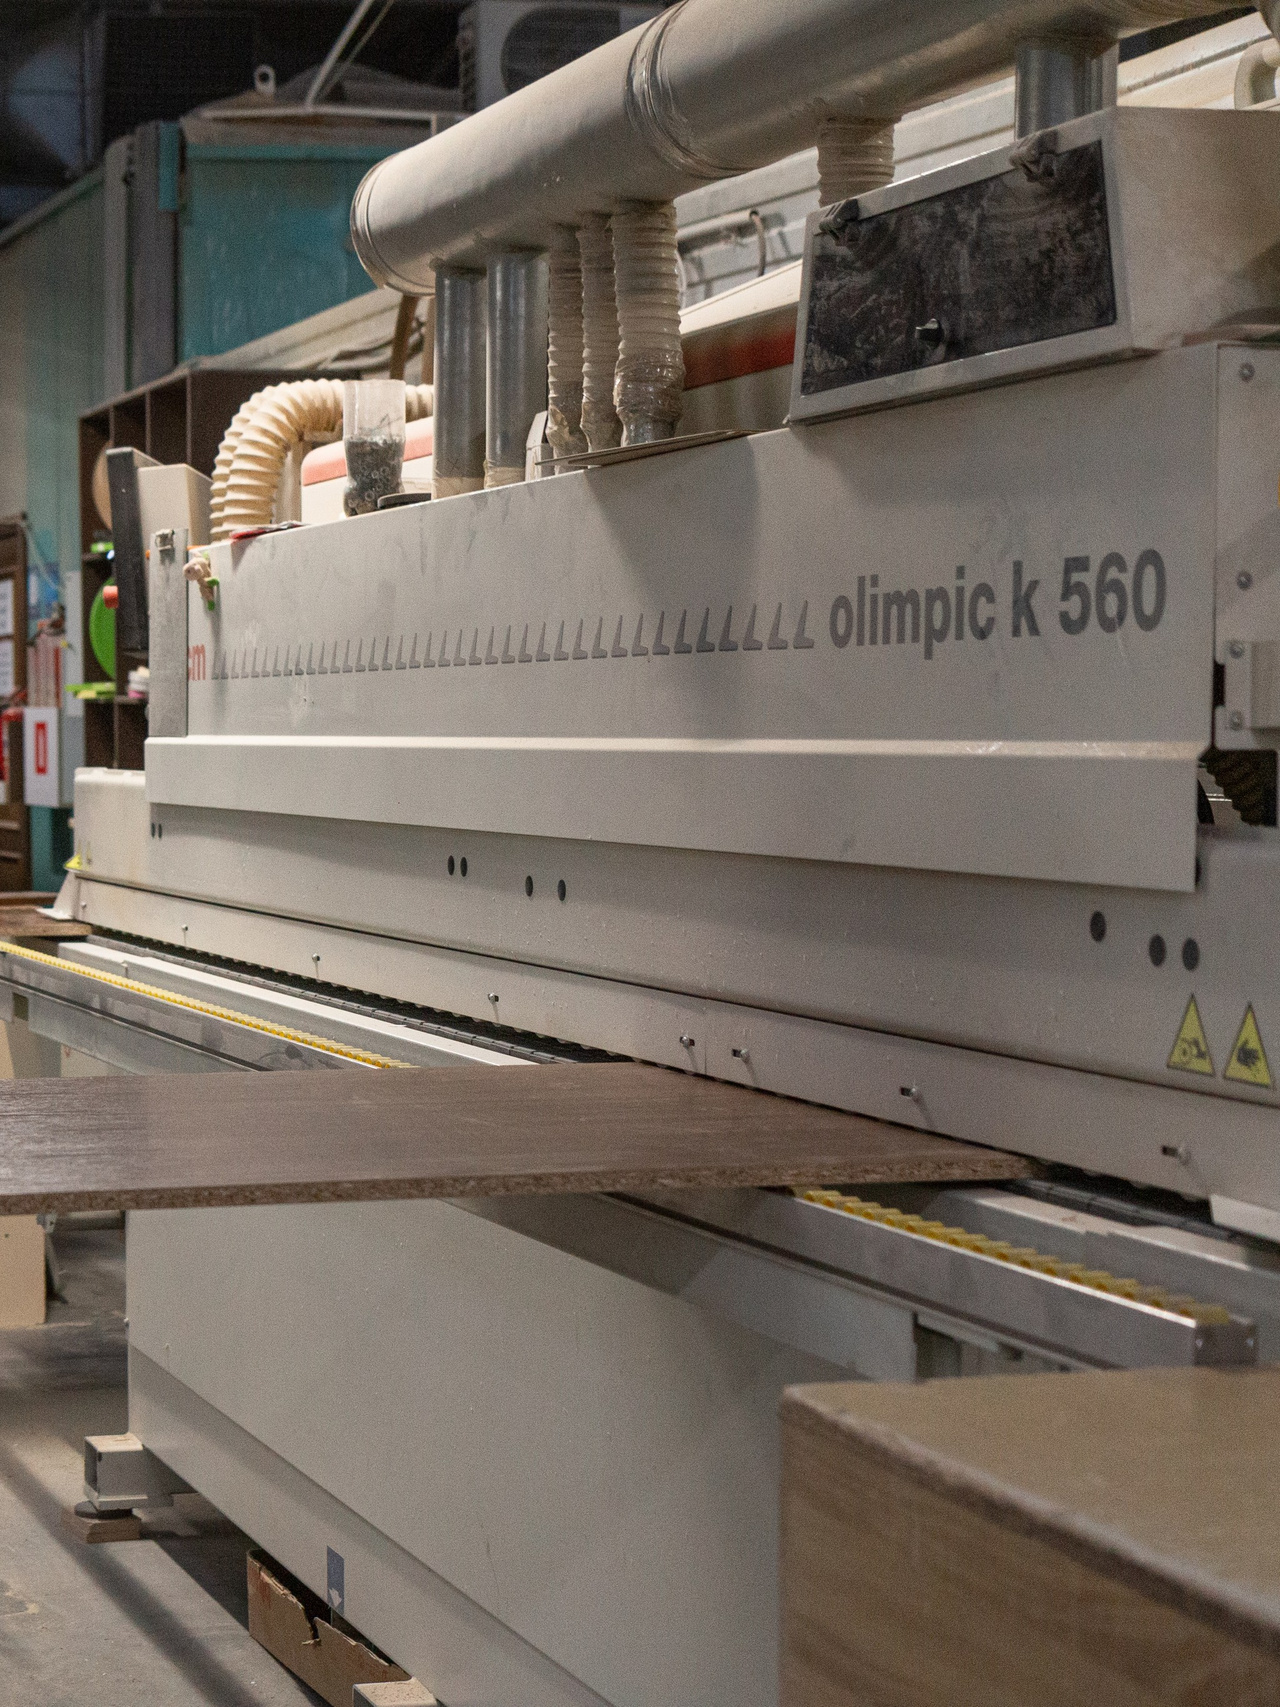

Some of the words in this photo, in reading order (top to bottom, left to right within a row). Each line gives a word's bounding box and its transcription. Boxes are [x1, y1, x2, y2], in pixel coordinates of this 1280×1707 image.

[829, 565, 996, 660] olimpic
[1011, 560, 1041, 638] k
[1058, 549, 1167, 635] 560
